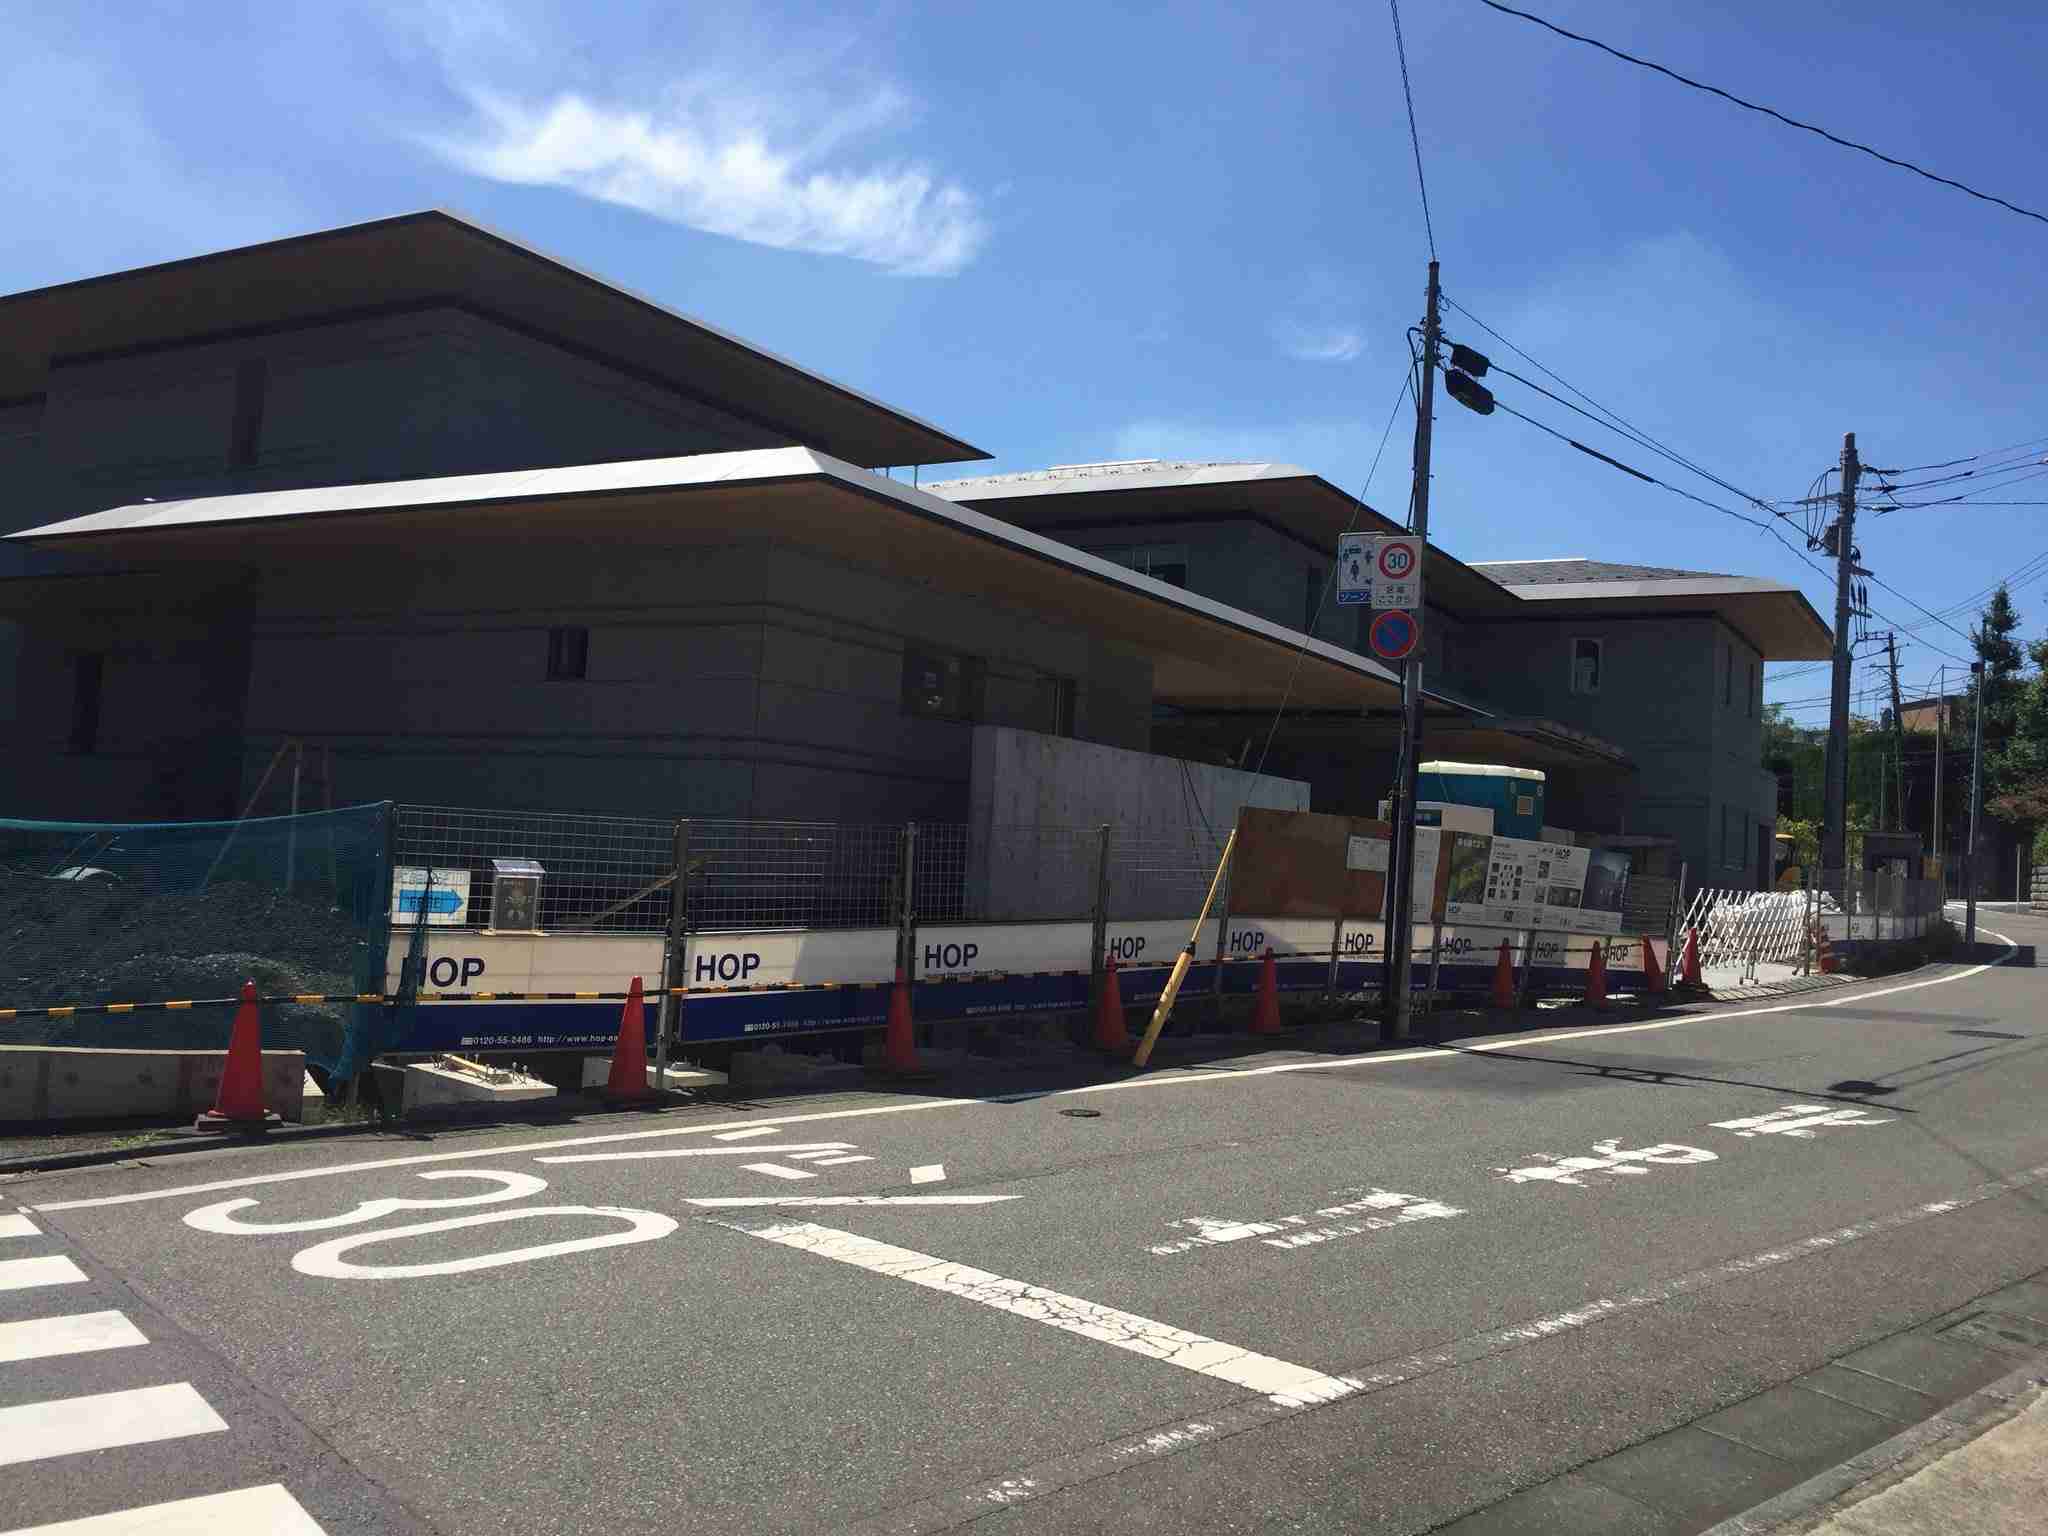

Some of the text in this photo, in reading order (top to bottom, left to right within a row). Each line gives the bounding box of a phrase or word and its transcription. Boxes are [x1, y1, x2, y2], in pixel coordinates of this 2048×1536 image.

[1387, 552, 1408, 569] 30
[1110, 936, 1145, 959] HOP
[1230, 931, 1264, 952] HOP
[1345, 933, 1374, 951] HOP
[1445, 939, 1471, 955] HOP
[1535, 942, 1559, 959] HOP
[925, 944, 978, 969] HOP
[1608, 946, 1629, 962] HOP
[696, 953, 760, 982] HOP
[532, 1126, 1025, 1208] ゾーン
[181, 1169, 679, 1280] 30
